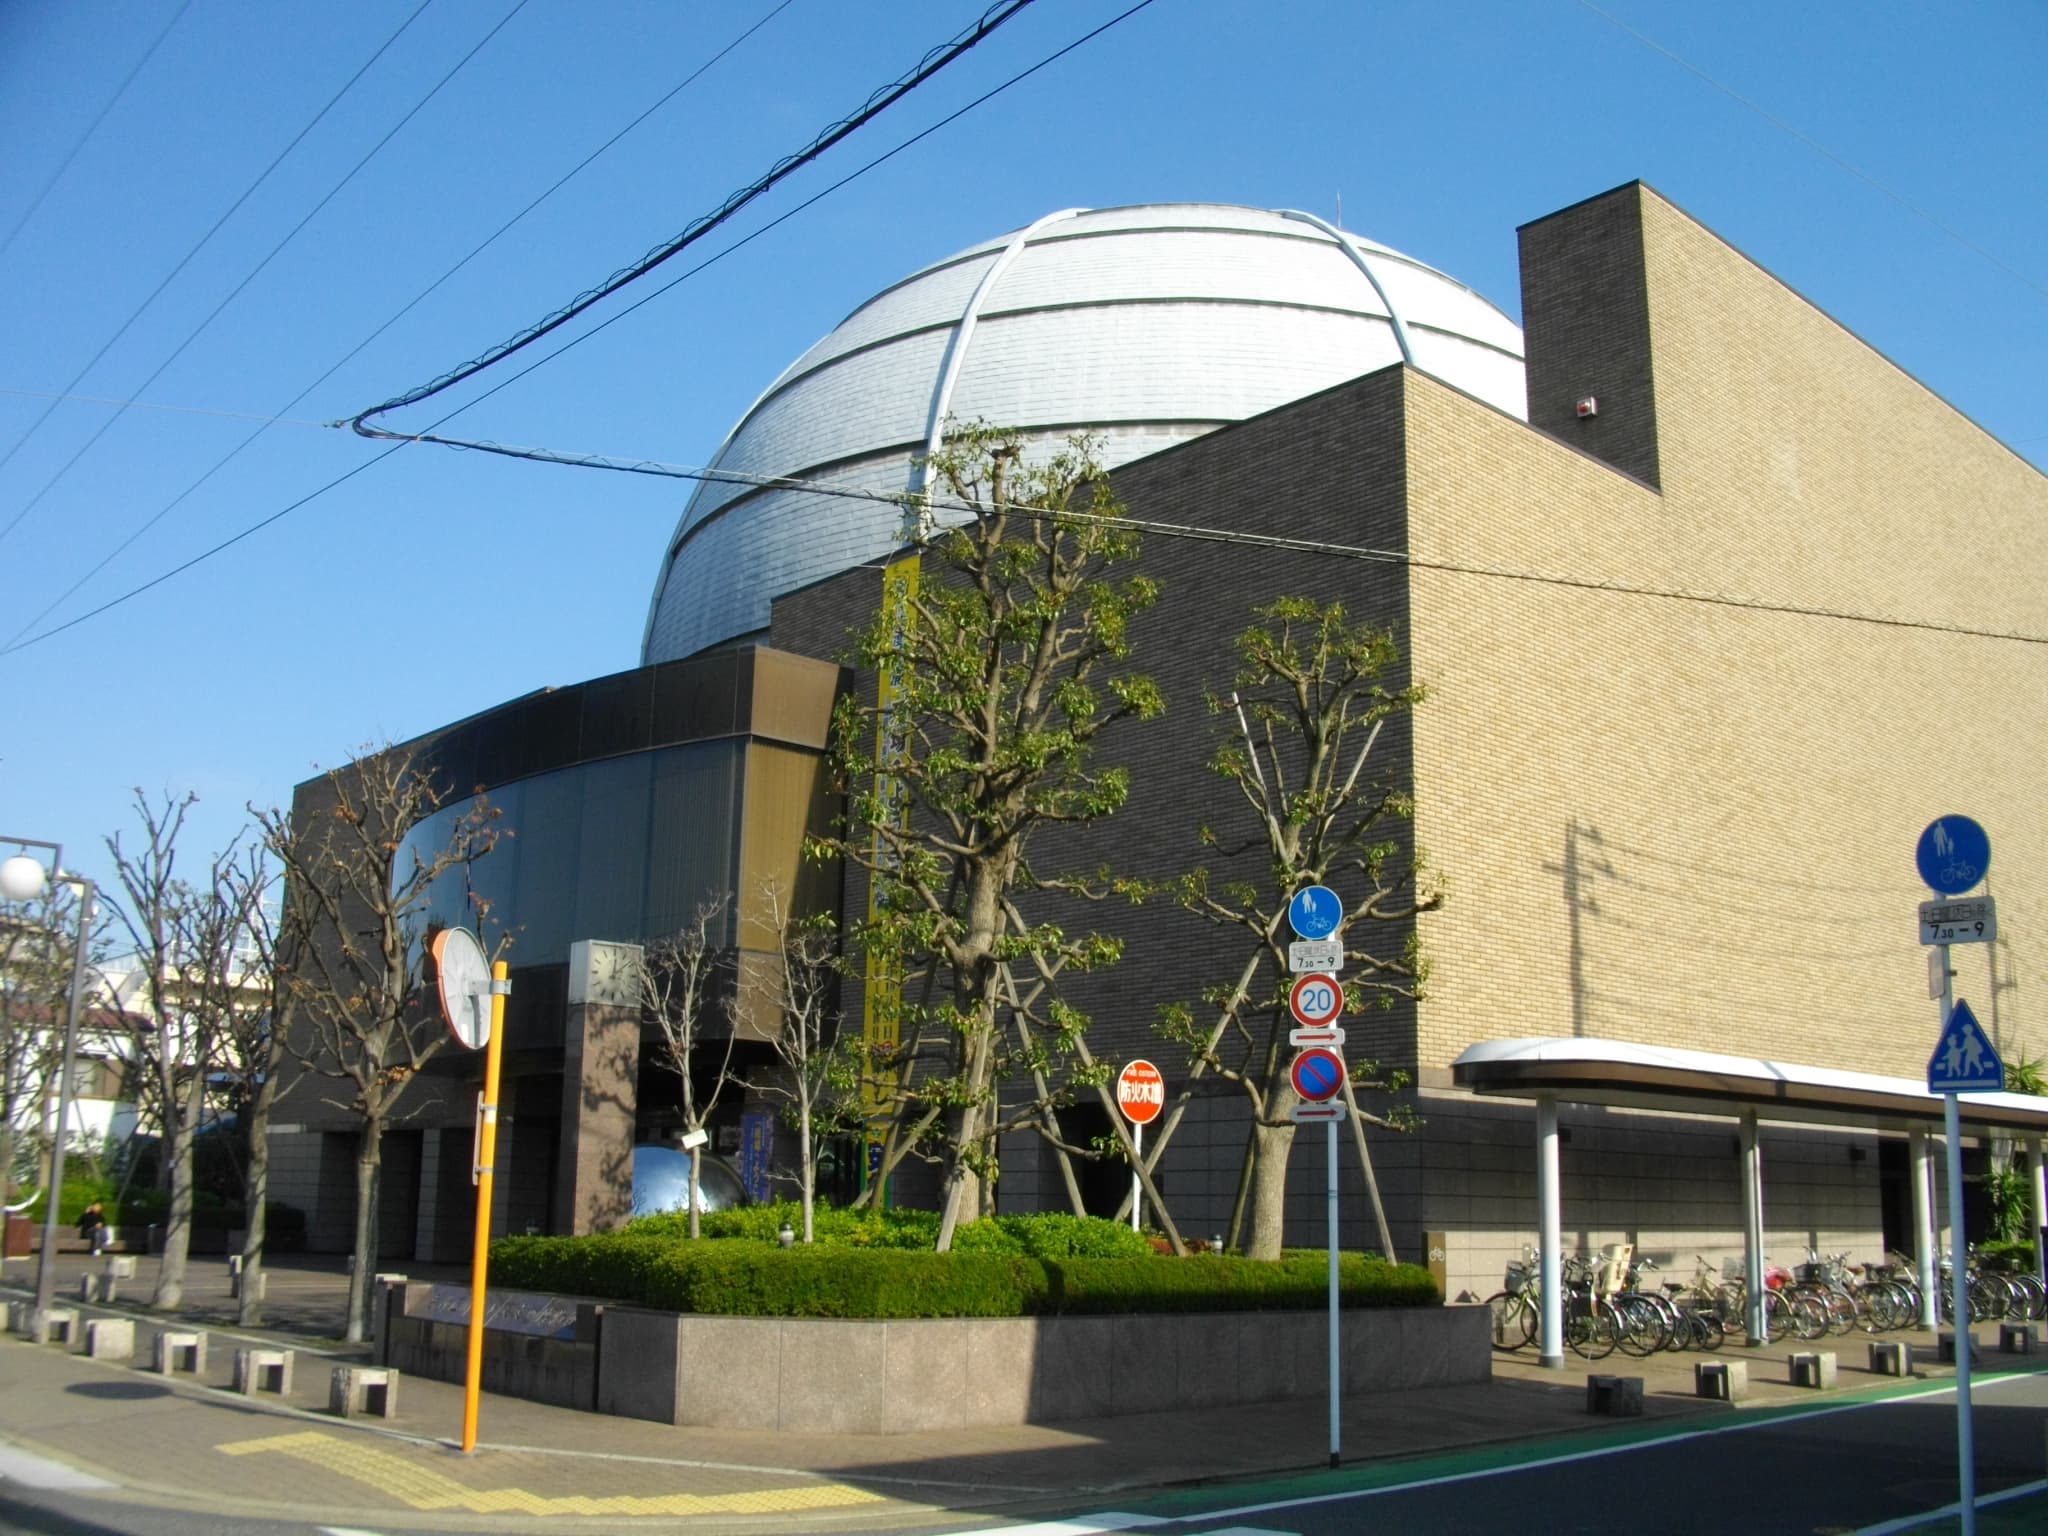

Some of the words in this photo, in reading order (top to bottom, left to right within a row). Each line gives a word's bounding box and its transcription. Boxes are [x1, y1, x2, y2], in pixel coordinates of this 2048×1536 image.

[1974, 921, 1984, 936] 9
[1328, 956, 1335, 967] 9
[1302, 988, 1331, 1012] 20
